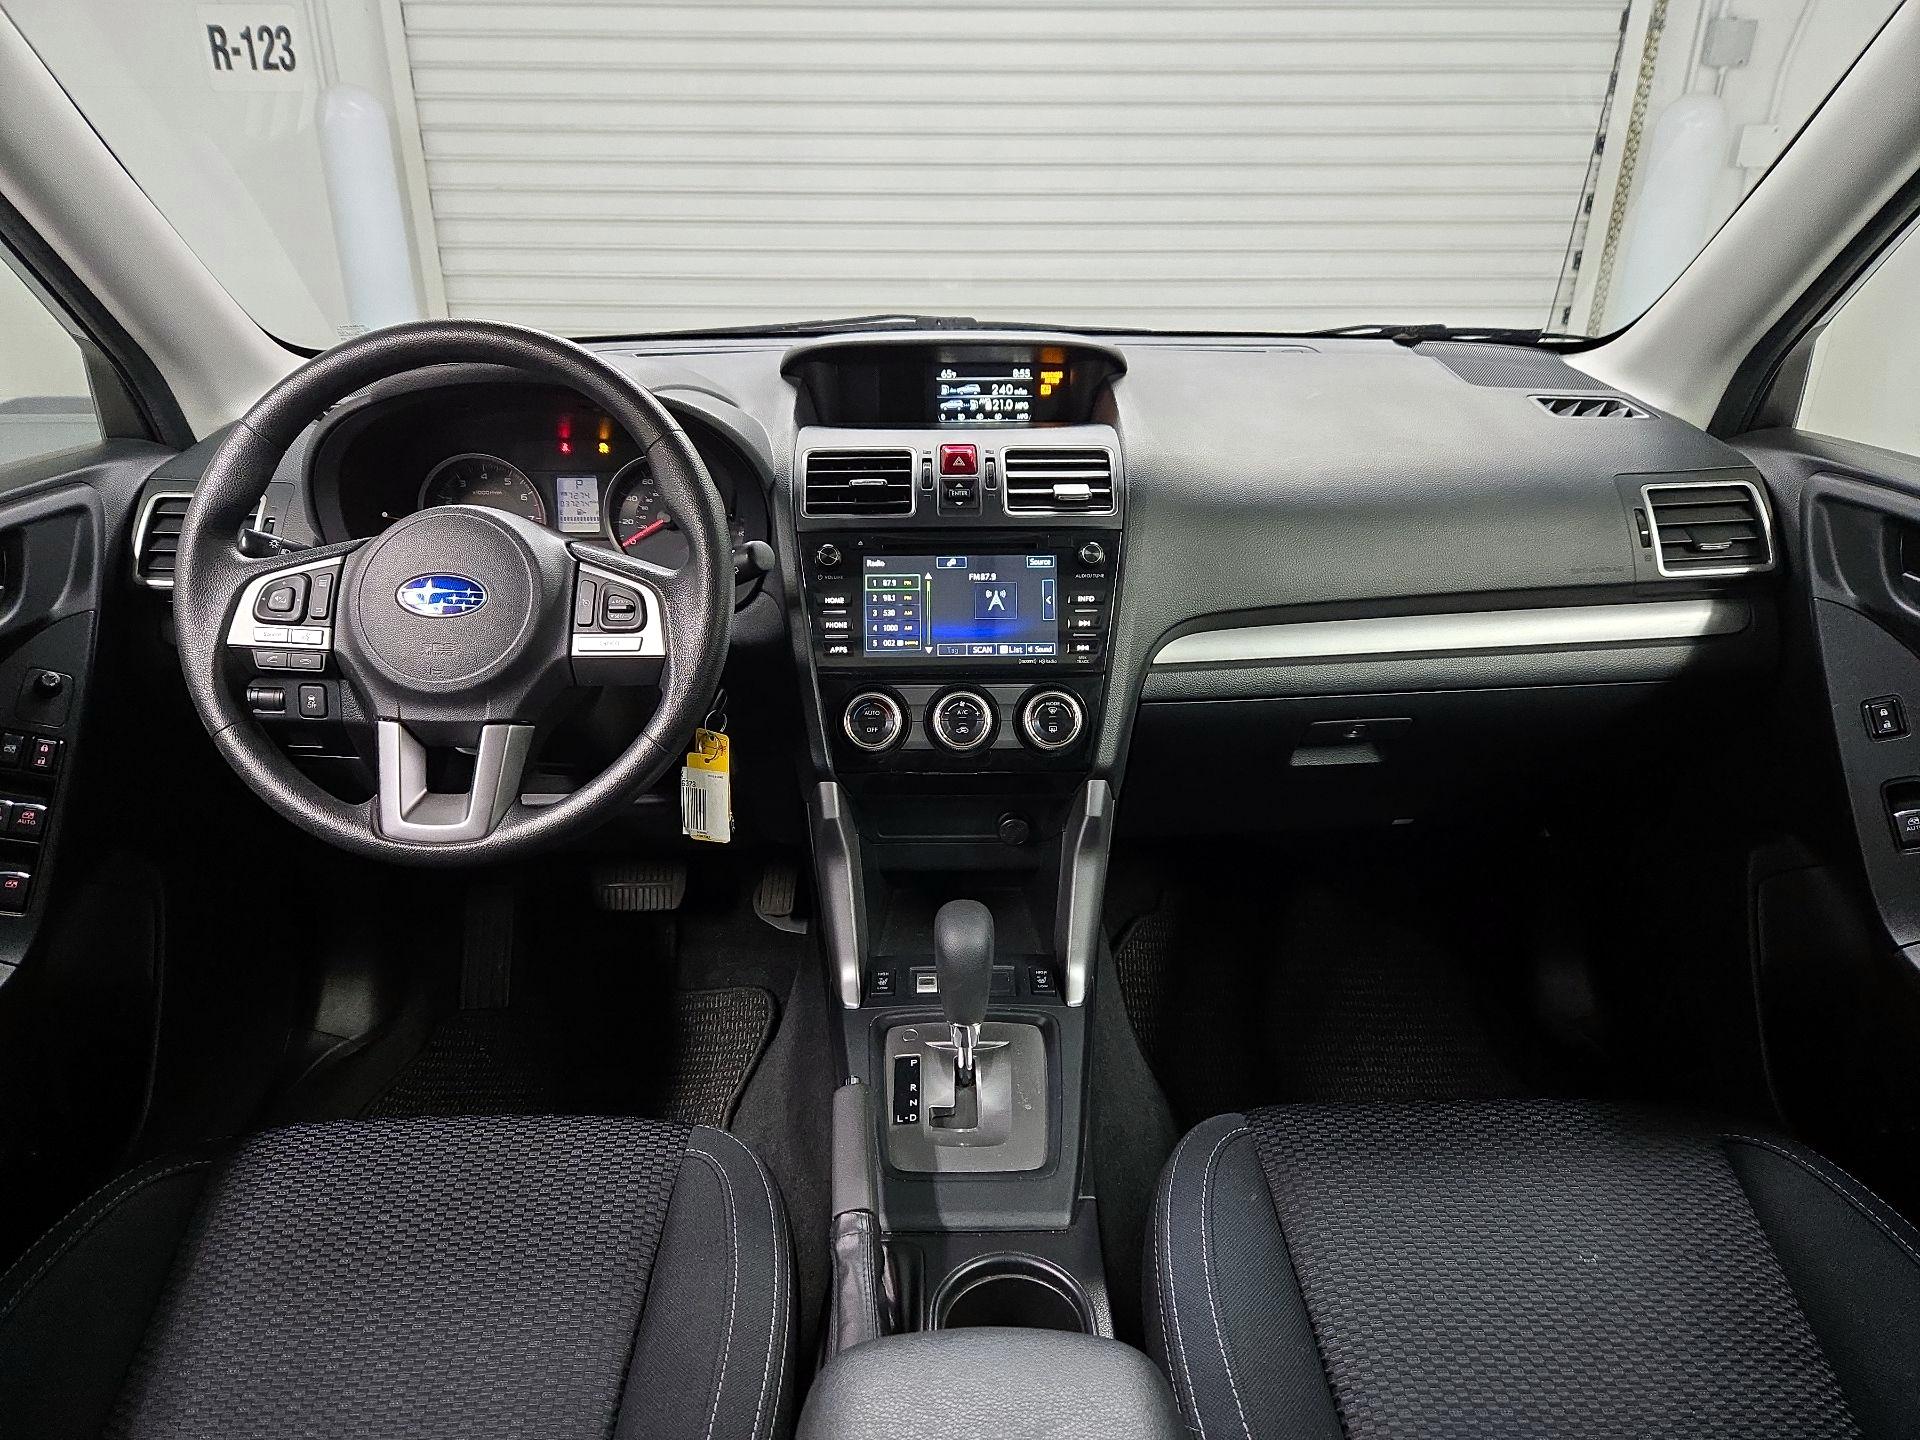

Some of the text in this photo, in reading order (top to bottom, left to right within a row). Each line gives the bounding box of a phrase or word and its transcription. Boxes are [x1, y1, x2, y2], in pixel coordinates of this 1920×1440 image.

[206, 24, 296, 72] R-123
[504, 477, 512, 486] 5
[520, 493, 528, 501] 6
[1029, 557, 1052, 567] Source
[1077, 595, 1096, 603] INFO
[825, 621, 848, 629] PHONE
[972, 646, 993, 654] SCAN
[1008, 645, 1024, 654] List
[17, 818, 37, 826] AUTO
[910, 1059, 918, 1067] P
[910, 1083, 918, 1092] R
[909, 1098, 918, 1107] N
